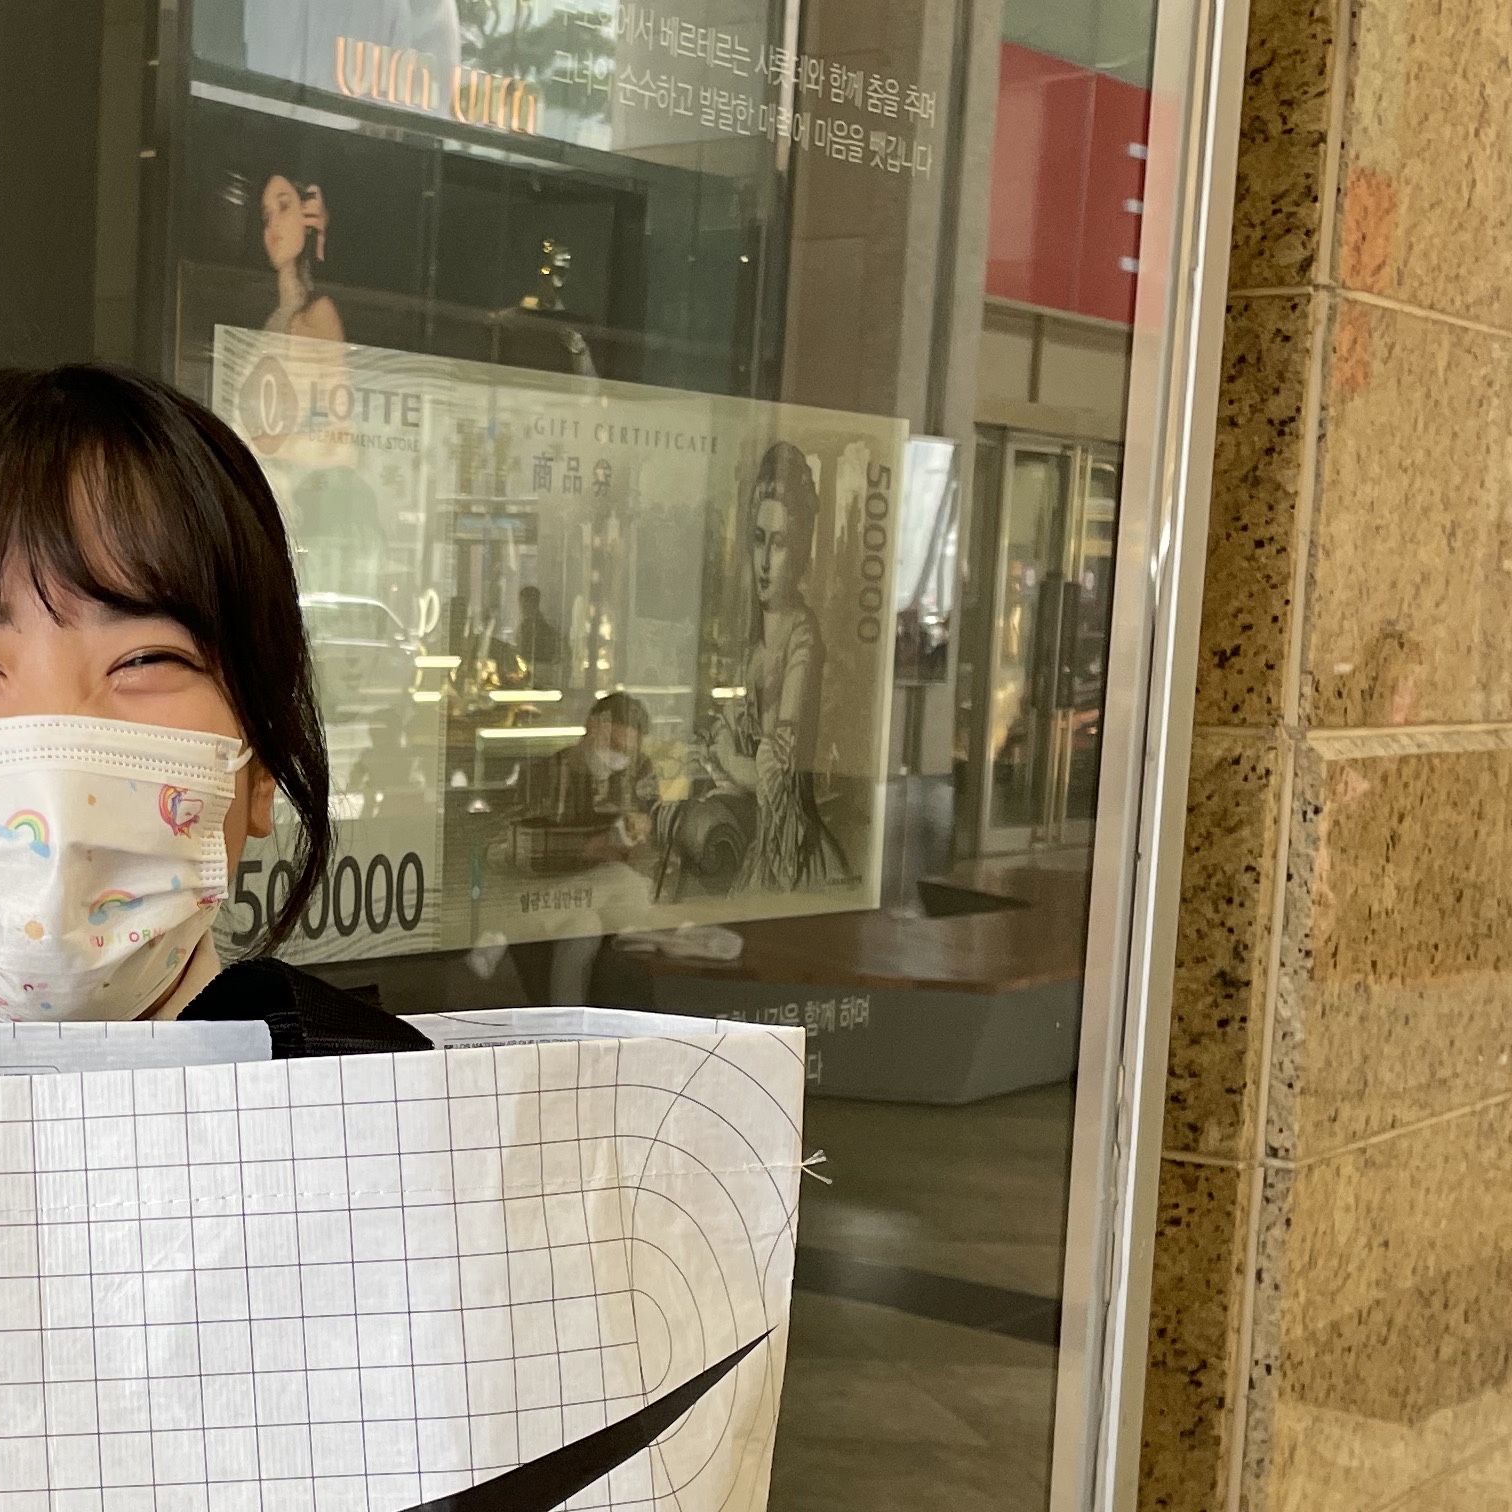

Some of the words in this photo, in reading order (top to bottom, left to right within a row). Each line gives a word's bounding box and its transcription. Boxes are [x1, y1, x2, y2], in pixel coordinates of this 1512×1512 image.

[660, 16, 751, 77] 베르테르는
[829, 62, 864, 110] 함께
[865, 73, 900, 118] 춤을
[903, 84, 937, 128] 추며
[551, 50, 612, 102] 그녀의
[617, 64, 694, 119] 순수하고
[699, 84, 752, 136] 발랄한
[757, 103, 811, 151] 매력에
[813, 117, 865, 165] 마음을
[868, 130, 934, 180] 뺏깁니다
[309, 380, 422, 428] LOTTE
[533, 415, 581, 439] GIFT
[593, 423, 719, 454] CERTIFICATE
[308, 430, 381, 450] DEPARTMENT
[387, 436, 421, 453] STORE
[857, 461, 892, 644] 500000
[231, 851, 425, 947] 500000
[805, 1000, 836, 1037] 함께
[840, 994, 870, 1031] 하며
